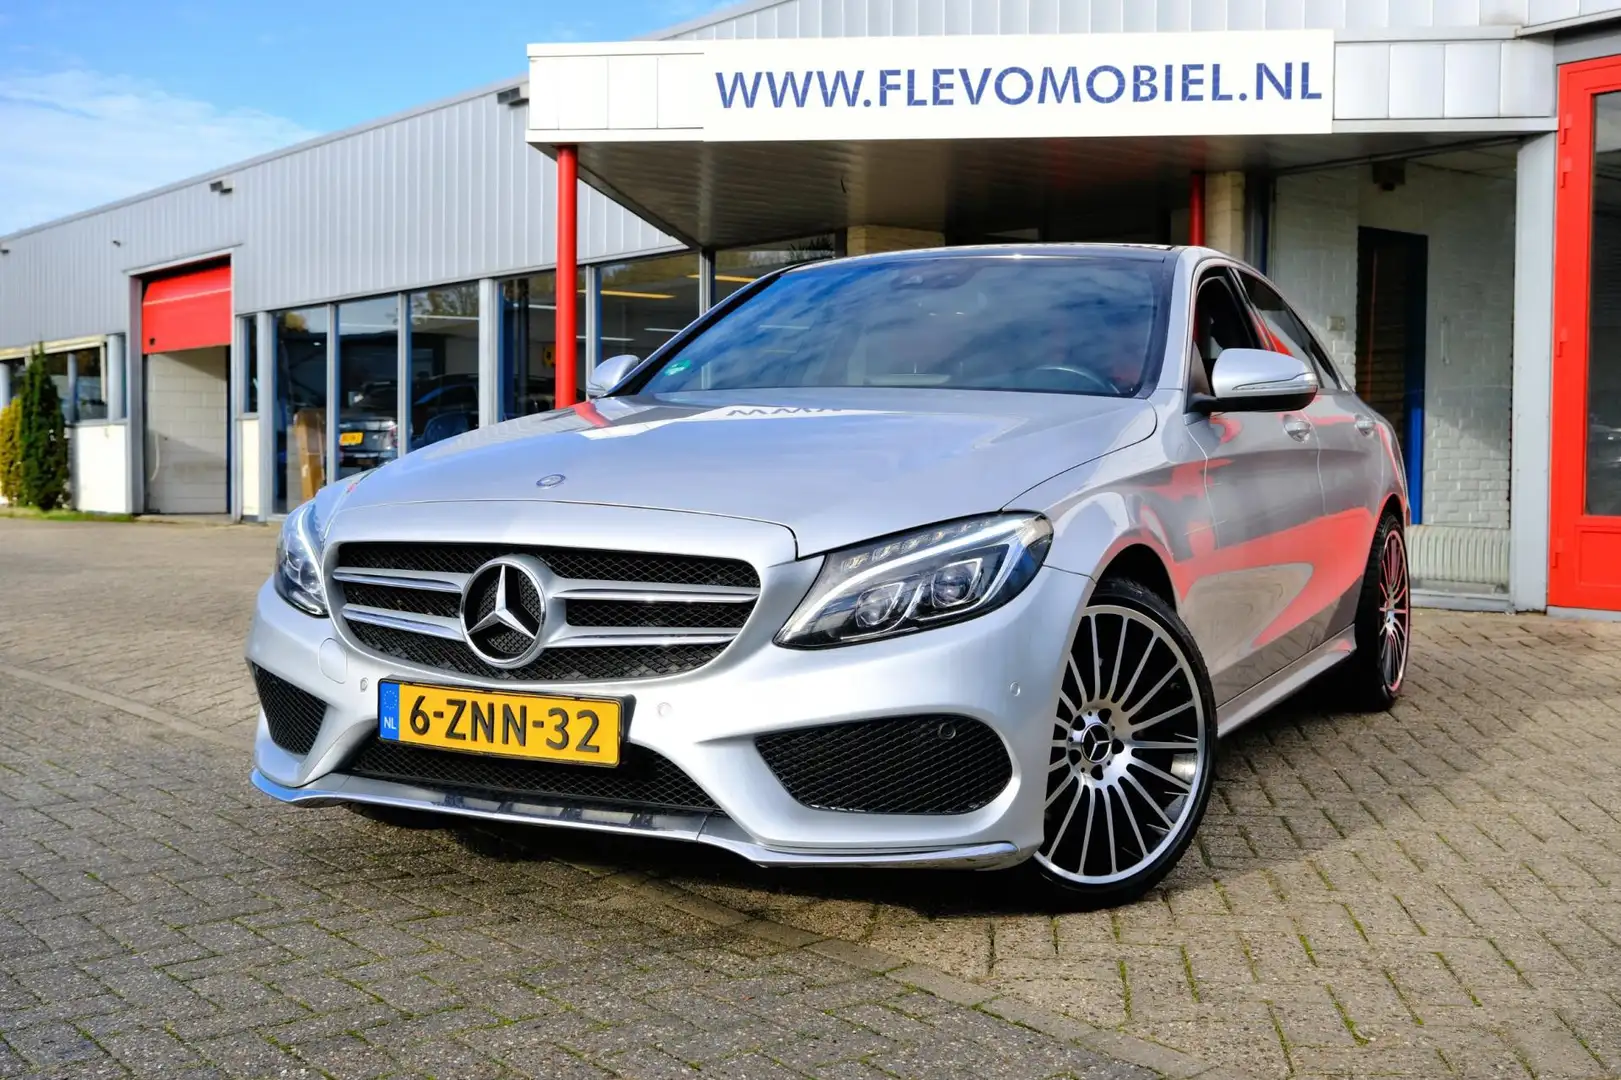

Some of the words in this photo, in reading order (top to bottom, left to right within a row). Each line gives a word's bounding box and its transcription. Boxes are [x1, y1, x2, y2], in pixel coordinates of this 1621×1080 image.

[715, 62, 1323, 109] WWW.FLEVOMOBIEL.NL
[383, 716, 397, 730] NL
[409, 695, 600, 753] 6-ZNN-32
